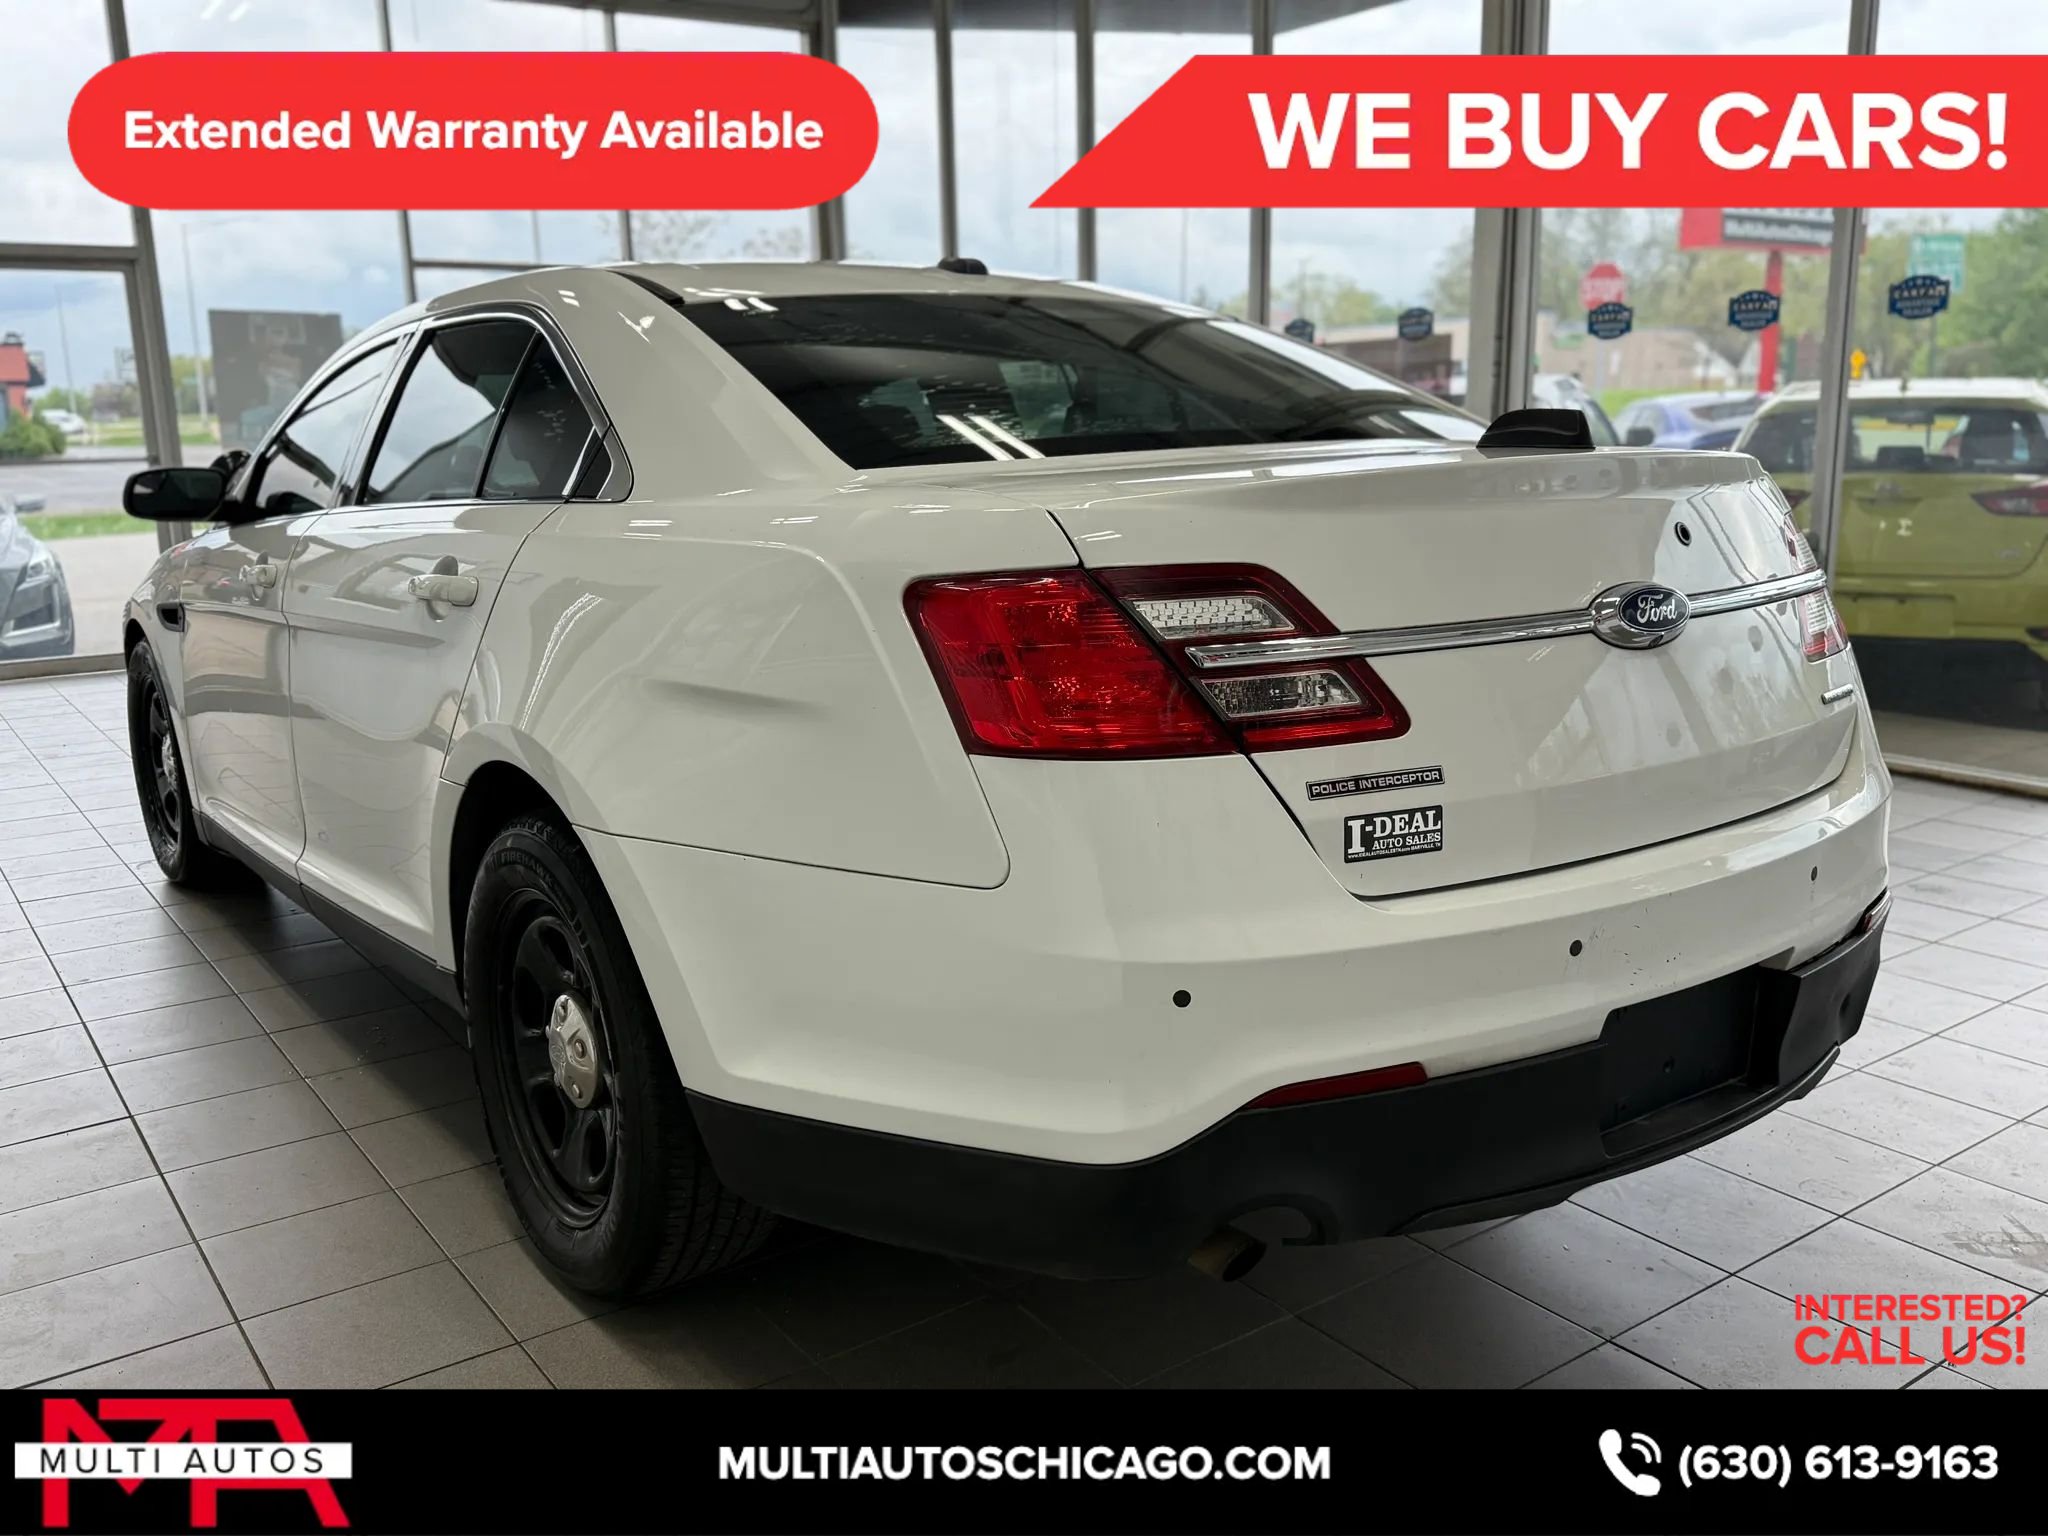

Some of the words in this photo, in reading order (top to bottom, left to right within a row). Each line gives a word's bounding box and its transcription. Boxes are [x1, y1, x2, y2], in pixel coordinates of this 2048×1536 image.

[1636, 593, 1678, 624] Ford
[1312, 781, 1356, 795] POLICE
[1359, 771, 1440, 789] INTERCEPTOR
[1347, 810, 1442, 854] I-DEAL
[1372, 837, 1403, 851] AUTO
[1406, 831, 1442, 847] SALES
